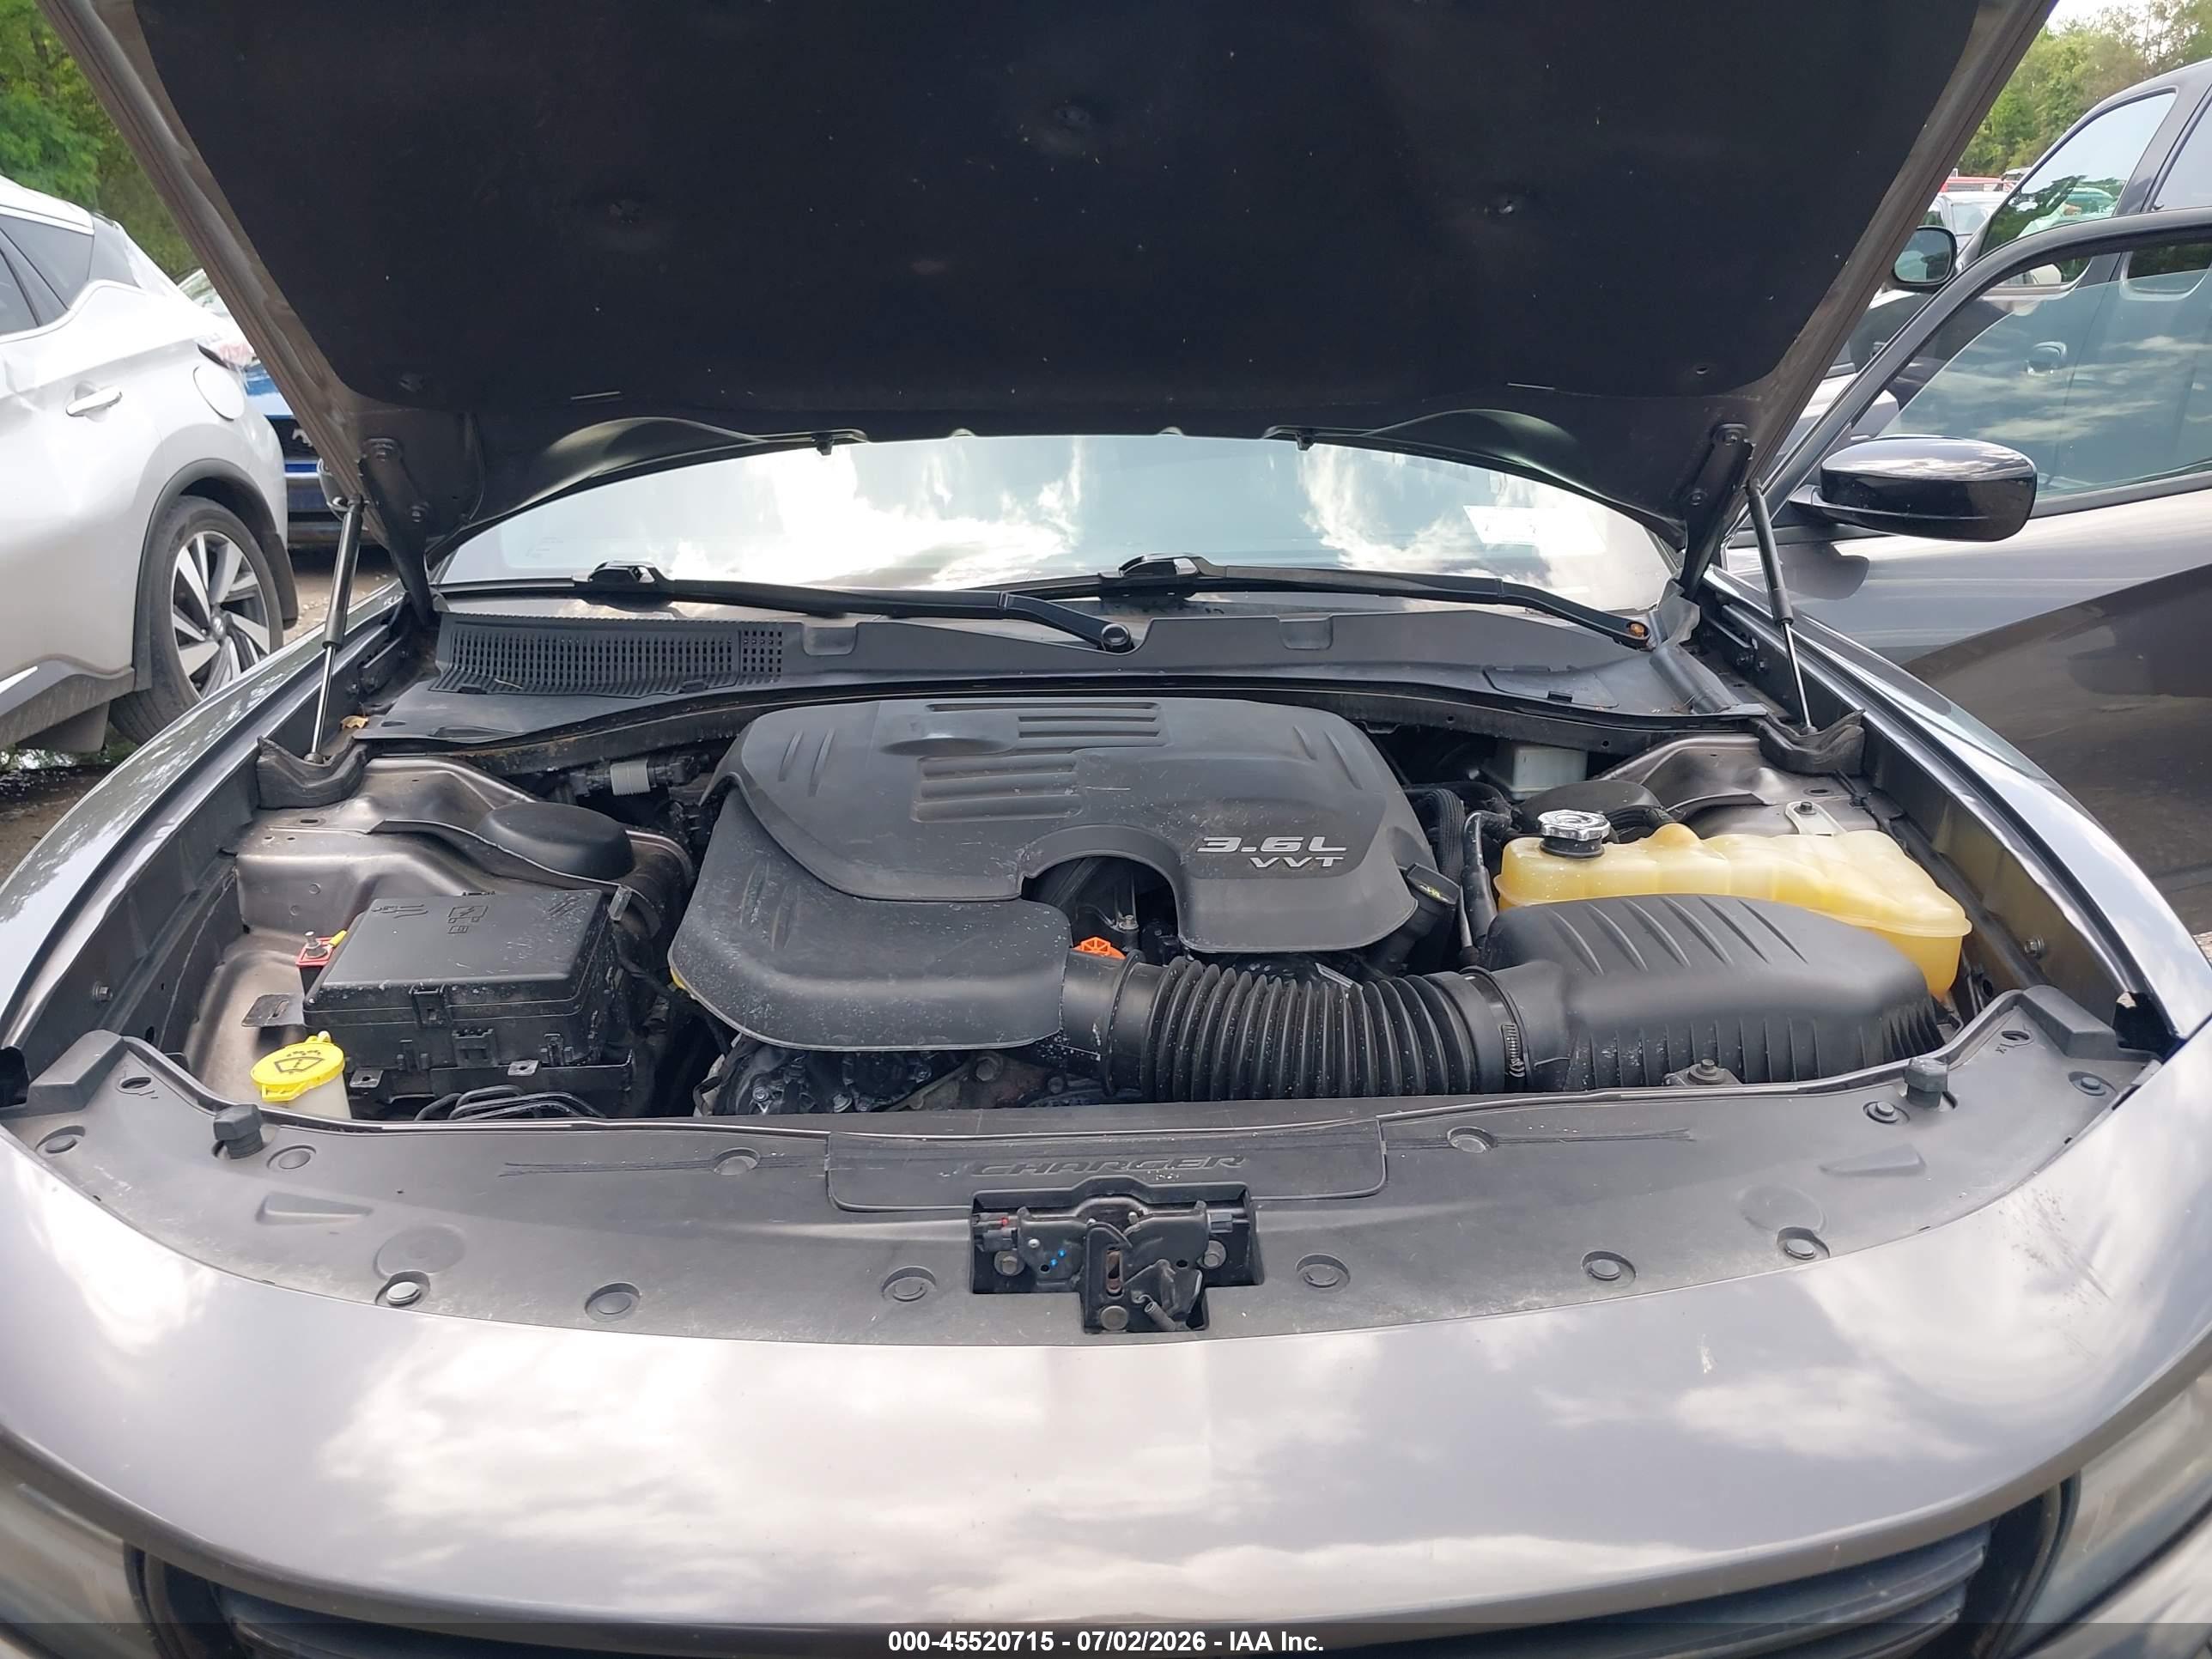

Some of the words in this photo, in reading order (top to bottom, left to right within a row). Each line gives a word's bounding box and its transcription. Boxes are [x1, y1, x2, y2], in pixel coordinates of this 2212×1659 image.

[1196, 836, 1347, 853] 3.6L
[1249, 856, 1345, 868] VVT
[971, 1156, 1246, 1176] CHARGER
